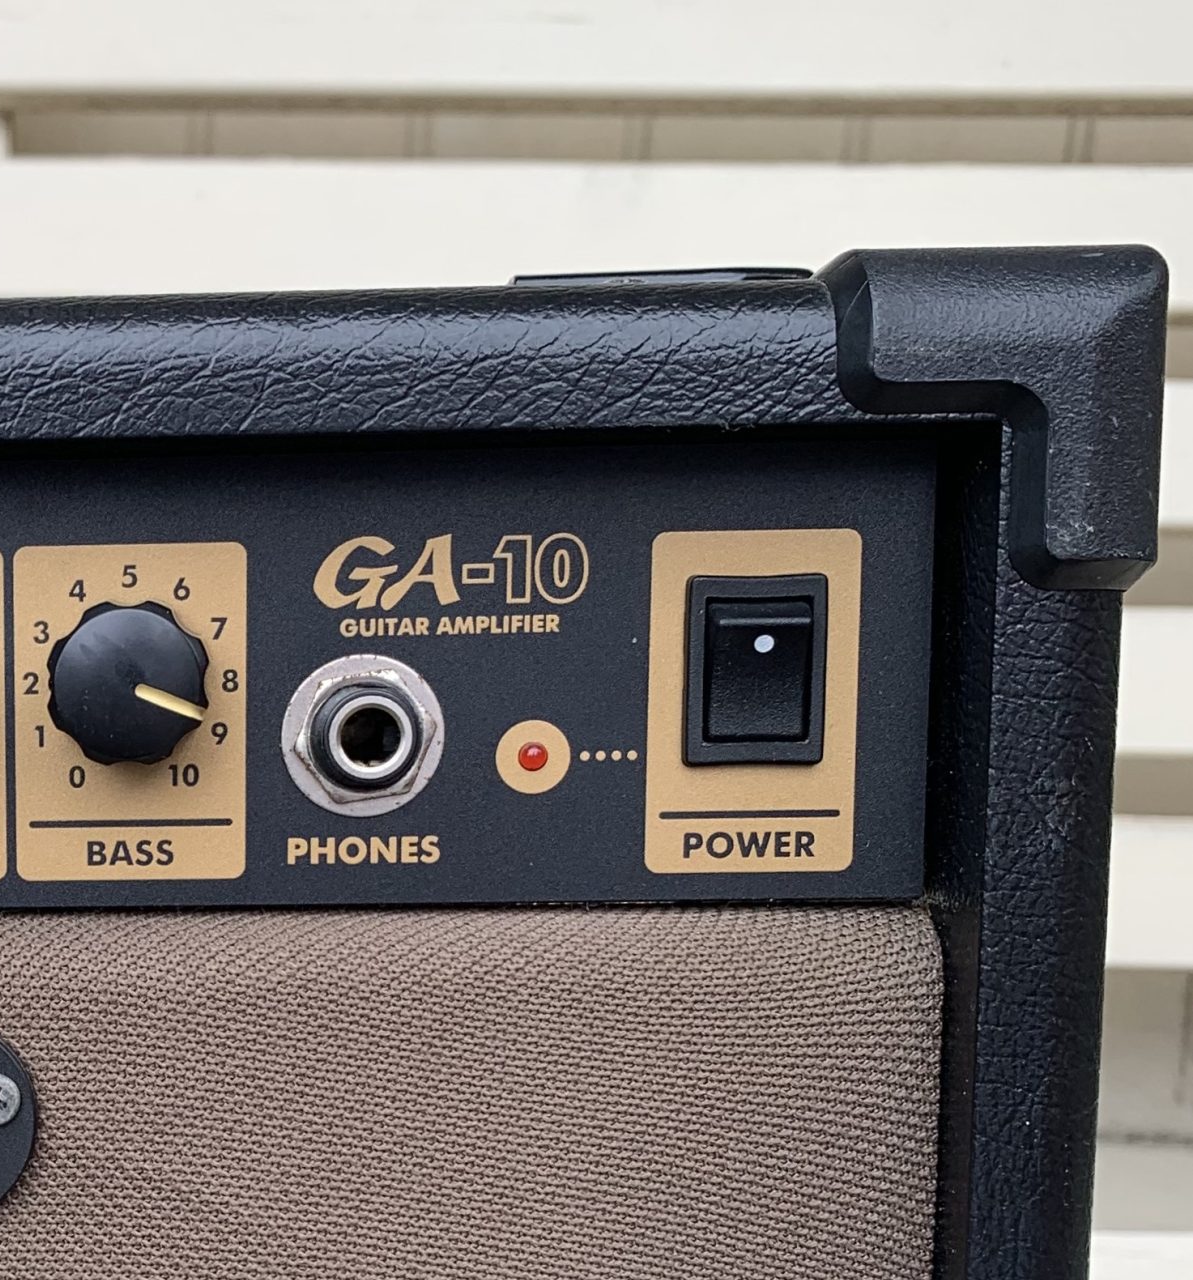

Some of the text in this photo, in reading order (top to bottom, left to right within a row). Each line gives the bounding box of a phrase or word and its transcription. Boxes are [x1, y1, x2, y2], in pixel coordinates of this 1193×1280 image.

[122, 565, 137, 588] 5
[312, 532, 589, 611] GA-10
[69, 580, 86, 601] 4
[173, 578, 190, 600] 6
[33, 621, 49, 644] 3
[211, 618, 227, 640] 7
[339, 614, 560, 638] GUITAR AMPLIFIER
[23, 672, 39, 694] 2
[222, 669, 238, 692] 8
[35, 725, 44, 747] 1
[211, 722, 228, 745] 9
[69, 766, 85, 788] 0
[168, 764, 199, 786] 10
[87, 840, 174, 866] BASS
[286, 835, 441, 865] PHONES
[683, 831, 816, 858] POWER
